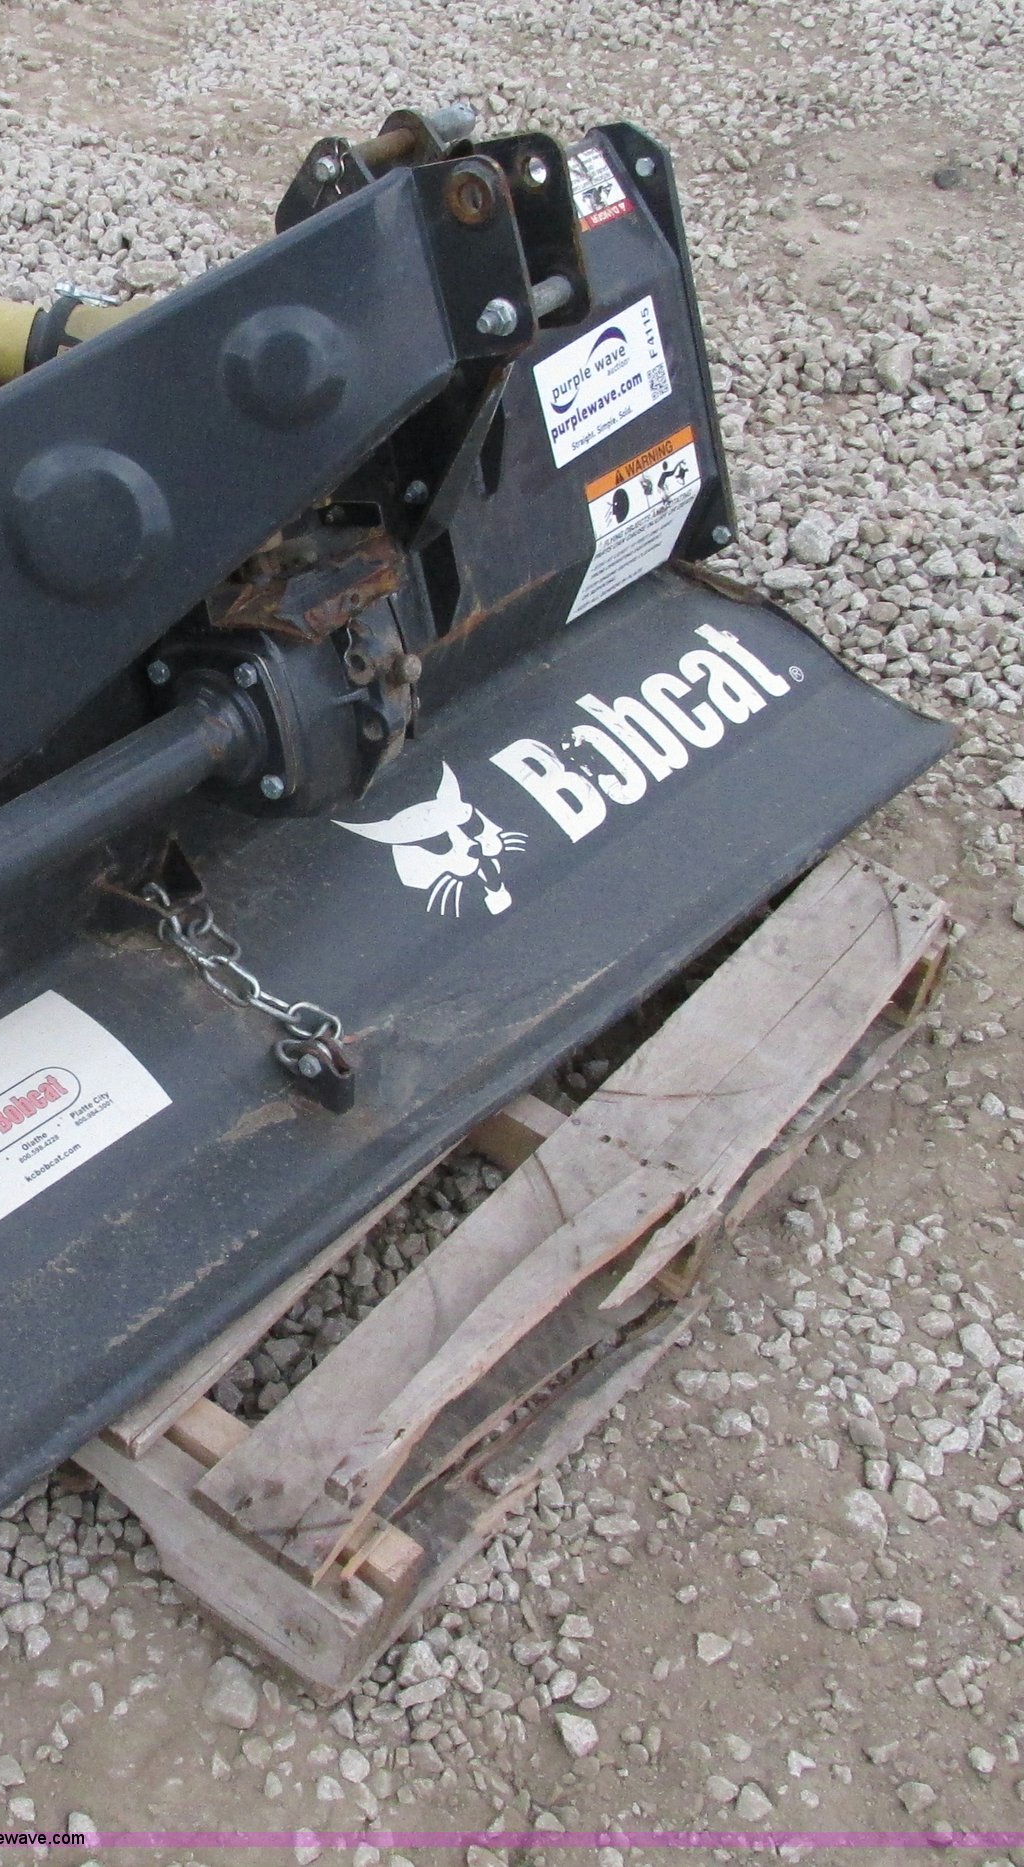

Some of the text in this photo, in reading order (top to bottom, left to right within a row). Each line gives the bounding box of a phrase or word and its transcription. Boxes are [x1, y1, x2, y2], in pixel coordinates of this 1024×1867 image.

[641, 307, 658, 359] F4115
[552, 345, 626, 403] purple wave
[551, 373, 643, 443] purplewave.com
[571, 406, 634, 451] Straight. Simple. Sold.
[626, 441, 674, 477] WARNING
[489, 623, 791, 843] Bobcat
[69, 1092, 110, 1119] Platte City
[21, 1132, 48, 1151] Olathe
[24, 1143, 82, 1182] kcbobcat.com
